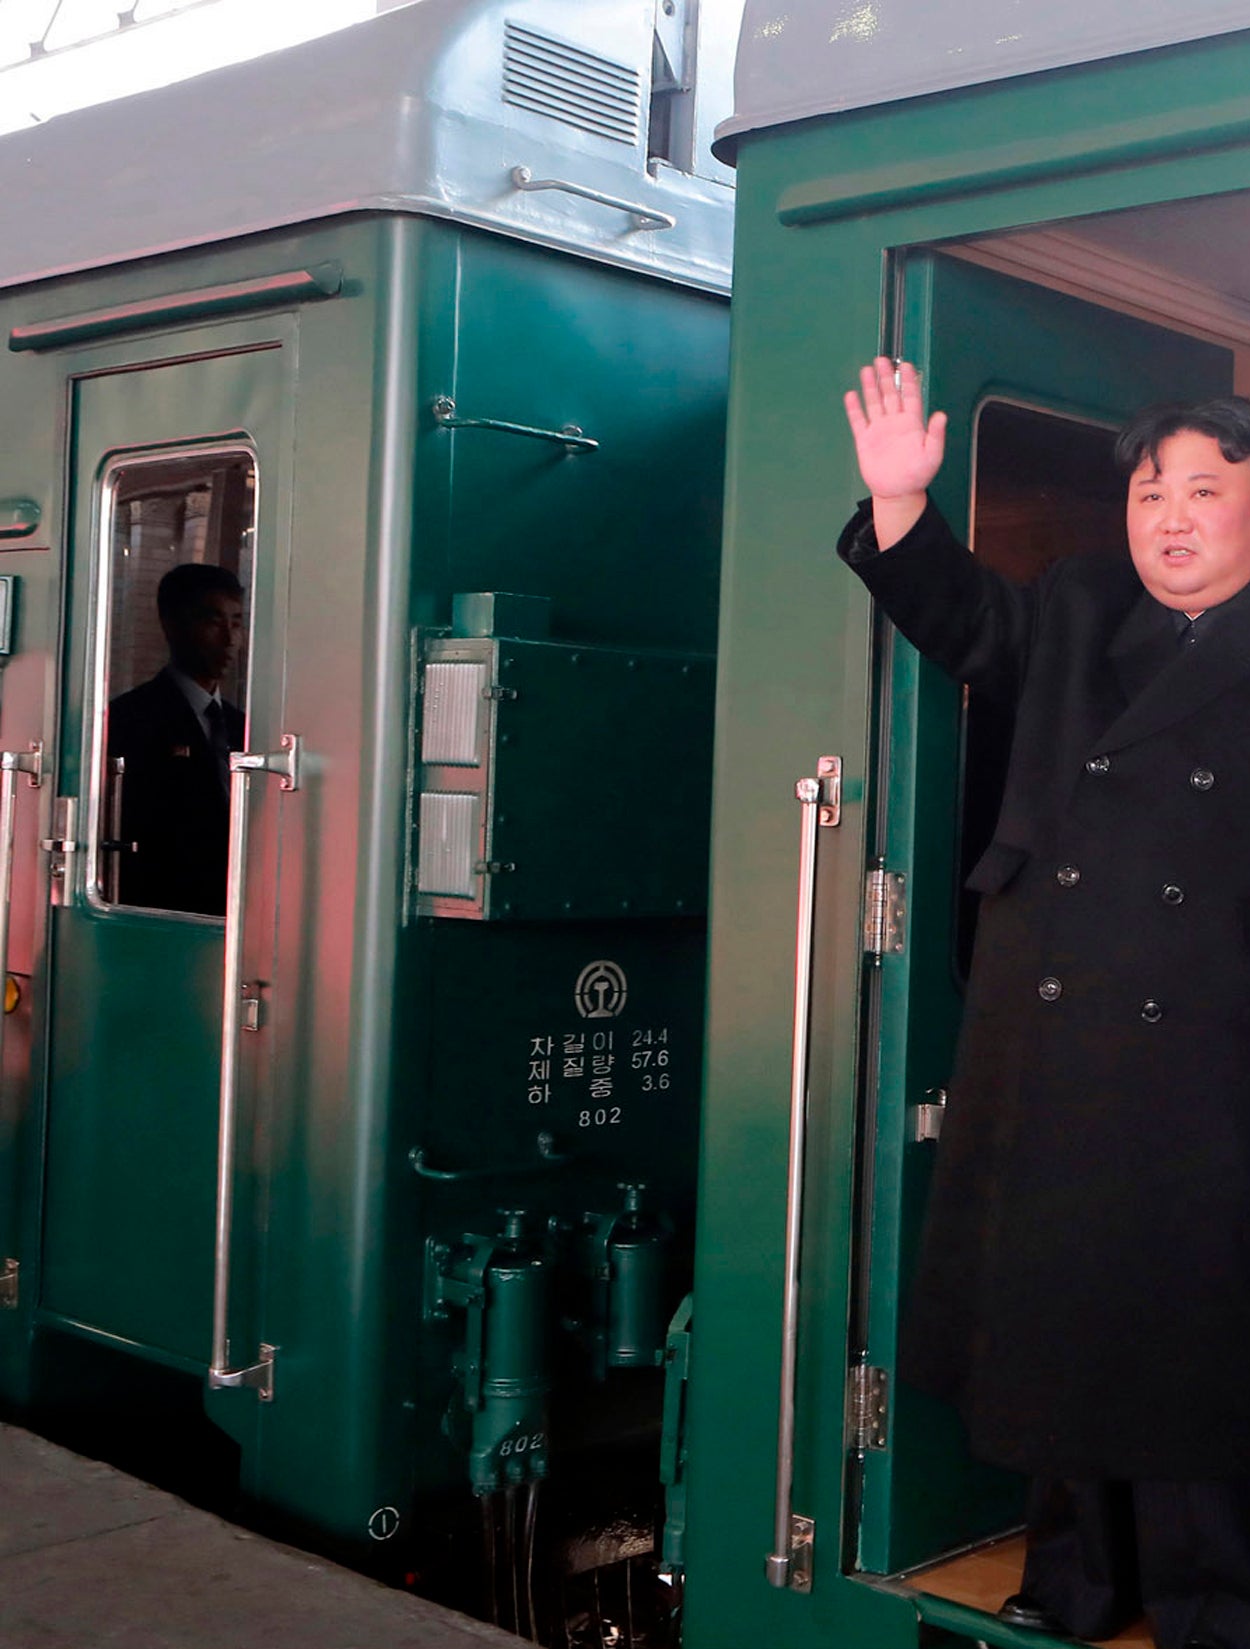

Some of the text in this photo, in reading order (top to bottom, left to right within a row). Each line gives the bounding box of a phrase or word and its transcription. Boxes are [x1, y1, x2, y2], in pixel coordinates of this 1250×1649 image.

[632, 1028, 668, 1047] 24.4
[631, 1049, 670, 1069] 57.6
[641, 1073, 670, 1091] 3.6
[578, 1106, 622, 1127] 802
[500, 1432, 543, 1456] 802
